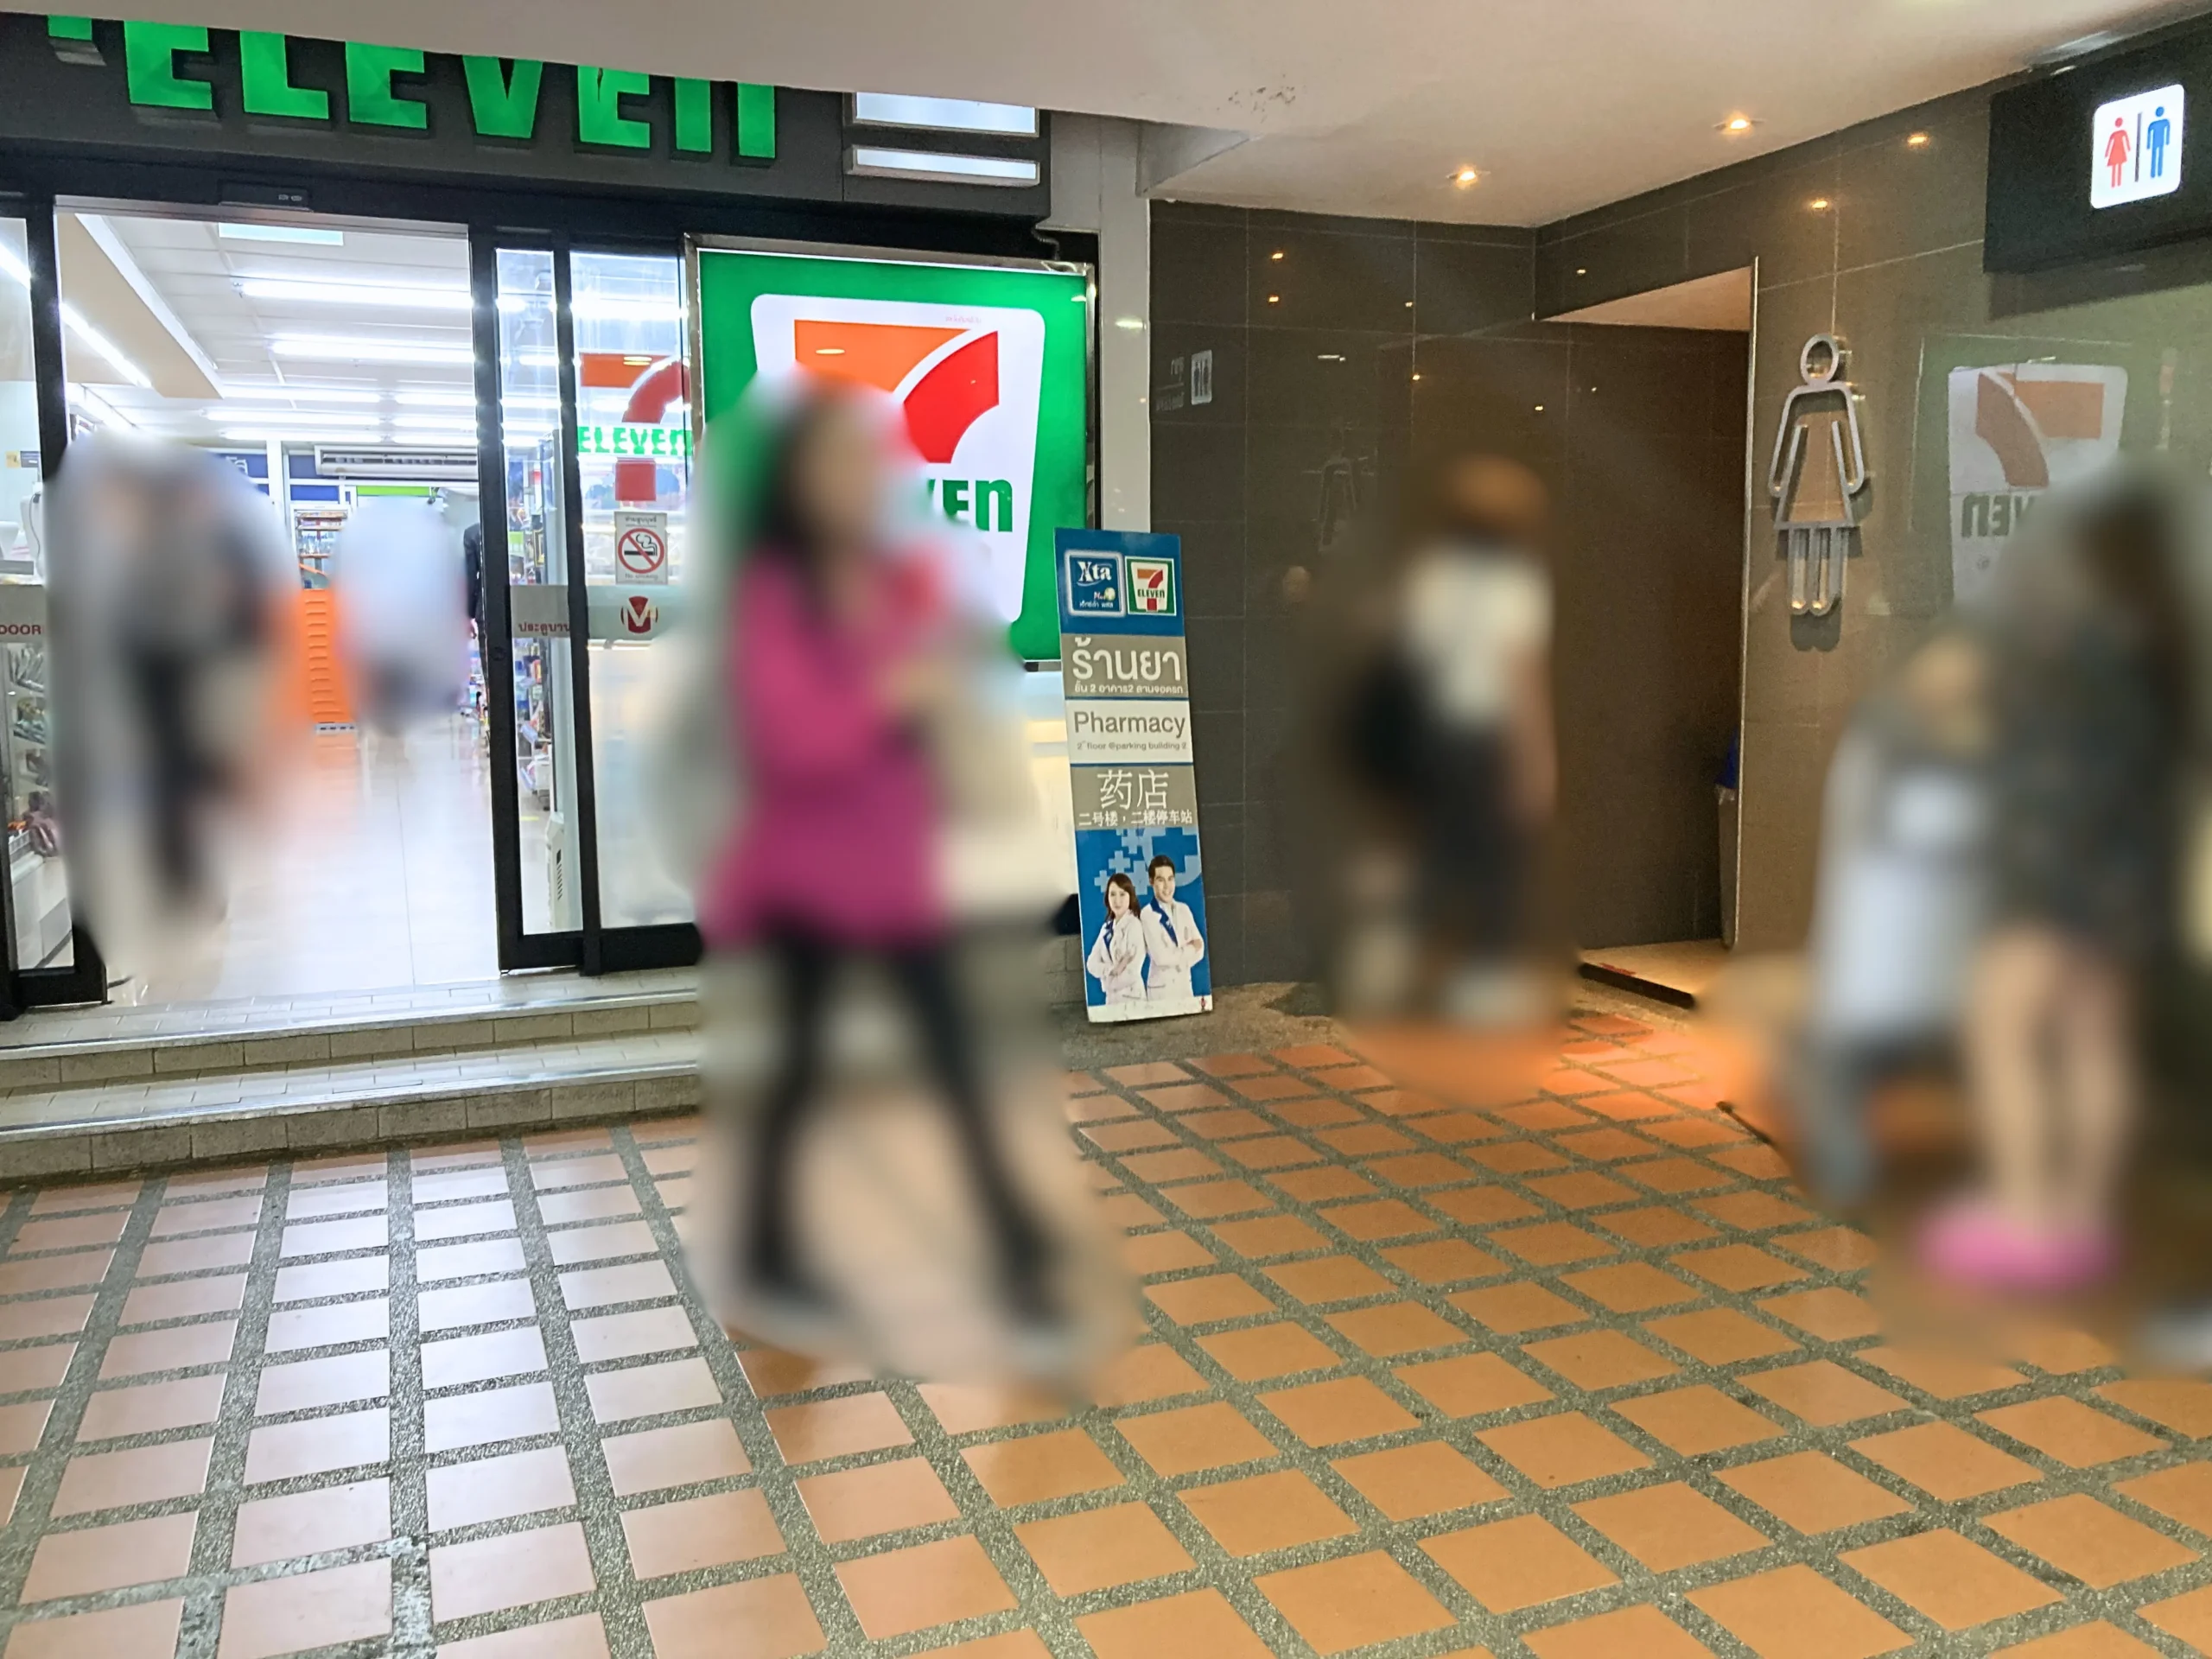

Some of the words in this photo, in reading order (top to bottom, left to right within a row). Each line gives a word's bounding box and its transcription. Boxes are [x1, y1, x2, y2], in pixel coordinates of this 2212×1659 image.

[1072, 637, 1181, 681] ร้านยา
[1073, 710, 1185, 739] Pharmacy
[1087, 741, 1107, 750] floor
[1147, 741, 1180, 751] building
[1181, 741, 1187, 750] 2
[1096, 769, 1169, 810] 药店
